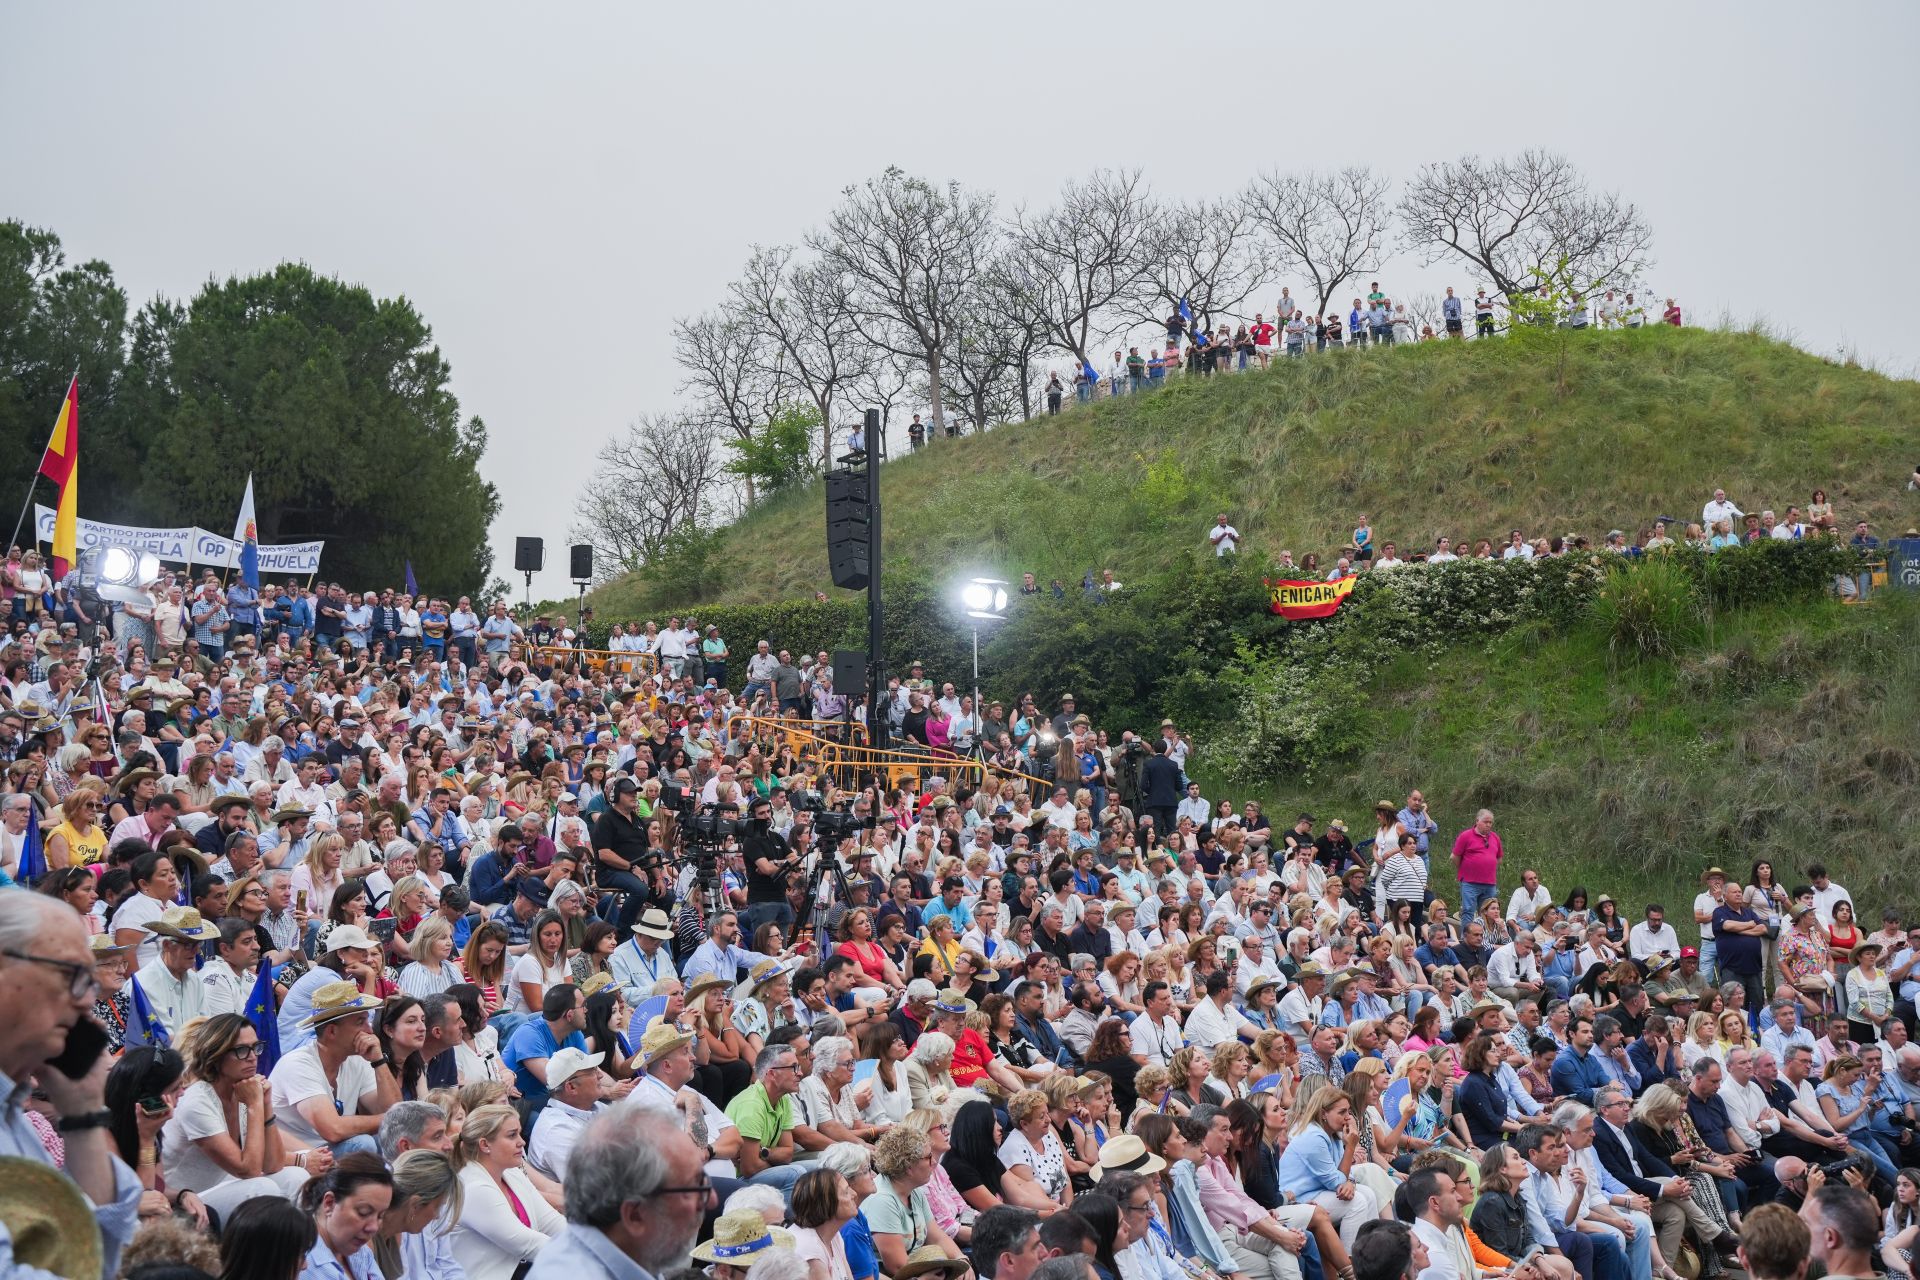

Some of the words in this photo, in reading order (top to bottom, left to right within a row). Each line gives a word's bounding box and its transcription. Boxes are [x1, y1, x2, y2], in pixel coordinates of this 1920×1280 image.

[84, 523, 134, 537] PARTIDO
[136, 530, 189, 540] POPULAR
[278, 545, 320, 553] POPULAR
[1901, 558, 1920, 567] vot
[1271, 584, 1342, 604] BENICARL
[78, 844, 98, 856] Day
